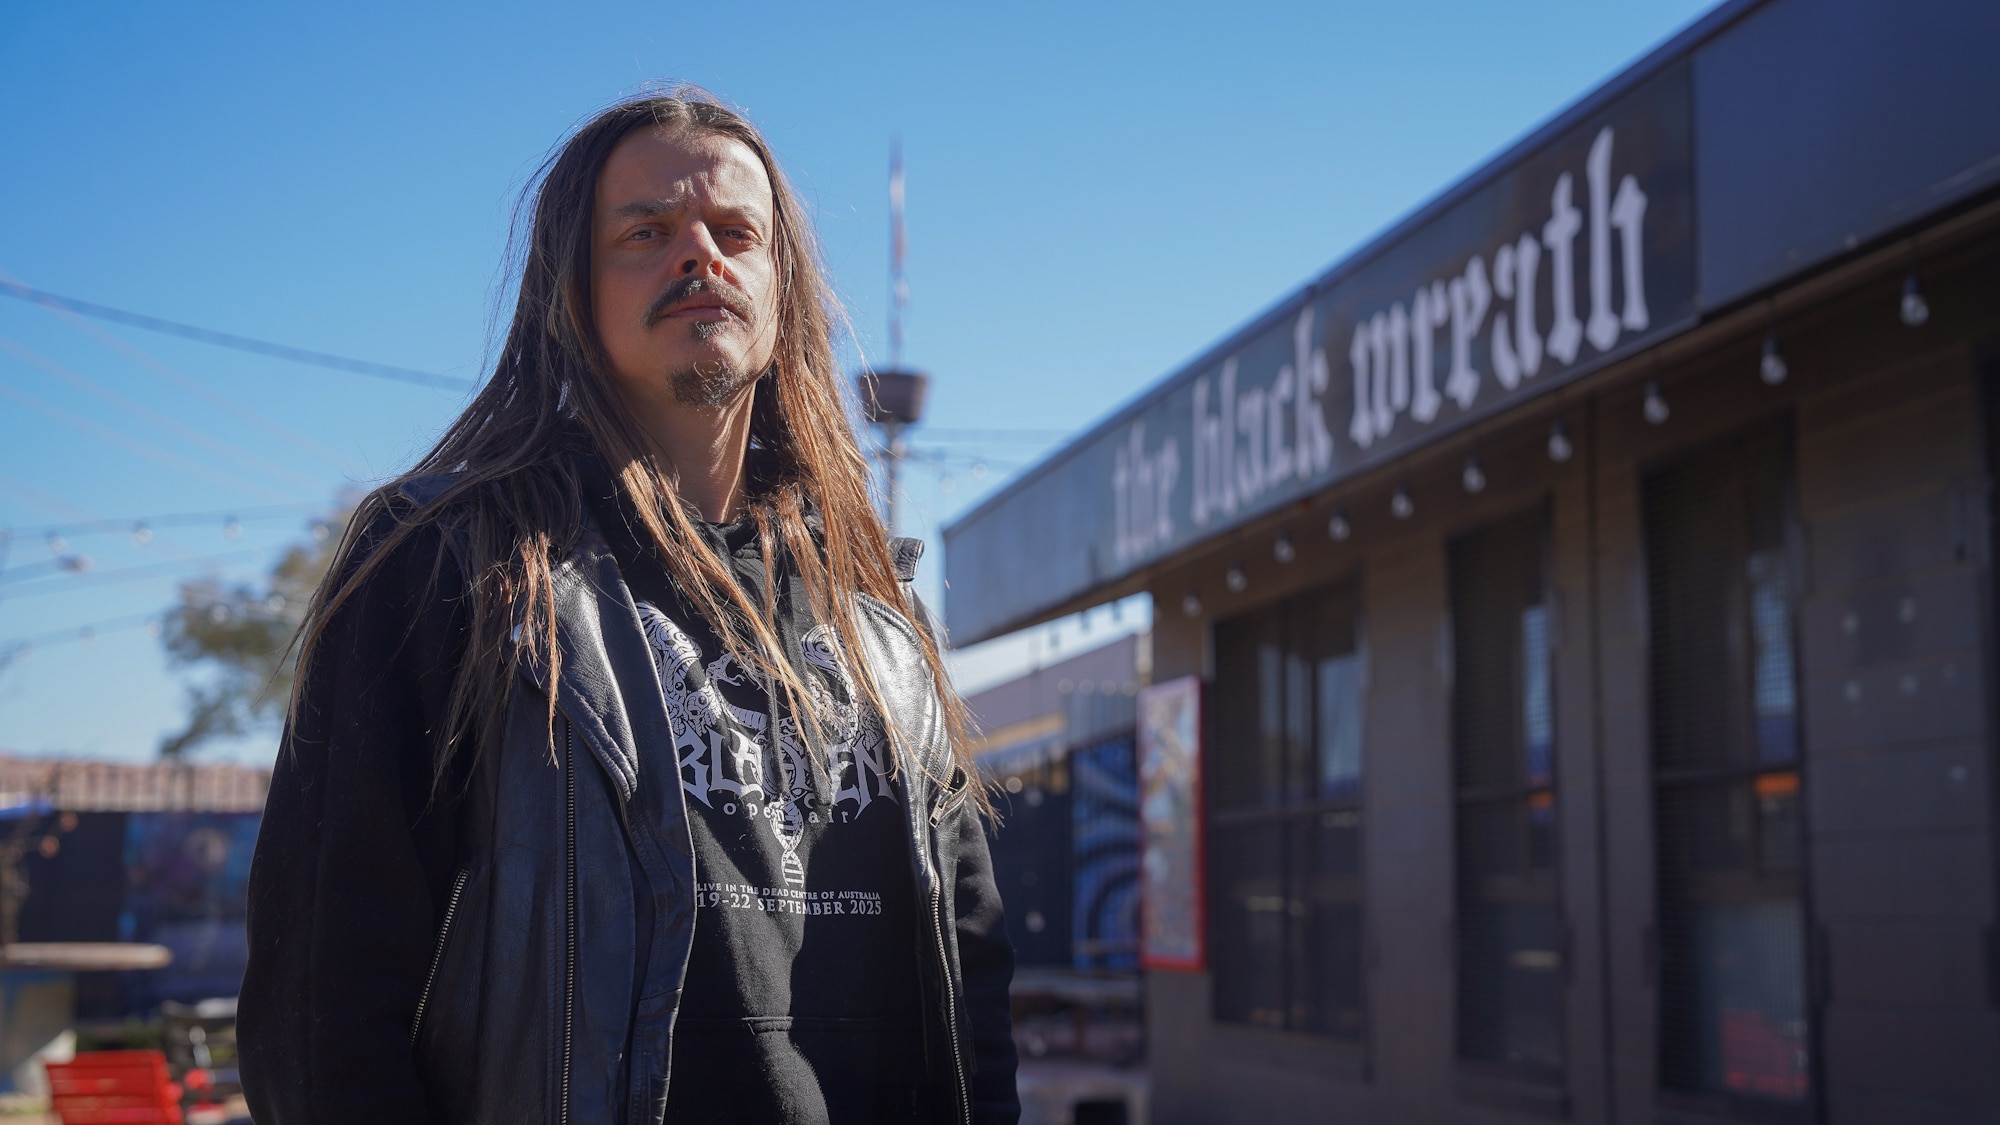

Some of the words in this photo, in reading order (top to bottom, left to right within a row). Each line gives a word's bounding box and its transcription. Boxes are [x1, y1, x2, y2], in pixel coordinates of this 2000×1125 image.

[1112, 419, 1181, 560] the
[1191, 305, 1333, 527] black
[1349, 125, 1650, 449] wreath
[723, 801, 785, 822] open
[808, 810, 848, 824] air
[697, 883, 721, 891] LIVE
[725, 884, 737, 893] IN
[740, 884, 759, 895] THE
[762, 887, 789, 897] DEAD
[790, 889, 818, 900] CENTRE
[821, 891, 834, 900] OF
[838, 891, 881, 900] AUSTRALIA
[697, 892, 751, 909] 19-22
[758, 897, 845, 916] SEPTEMBER
[850, 899, 882, 915] 2025
